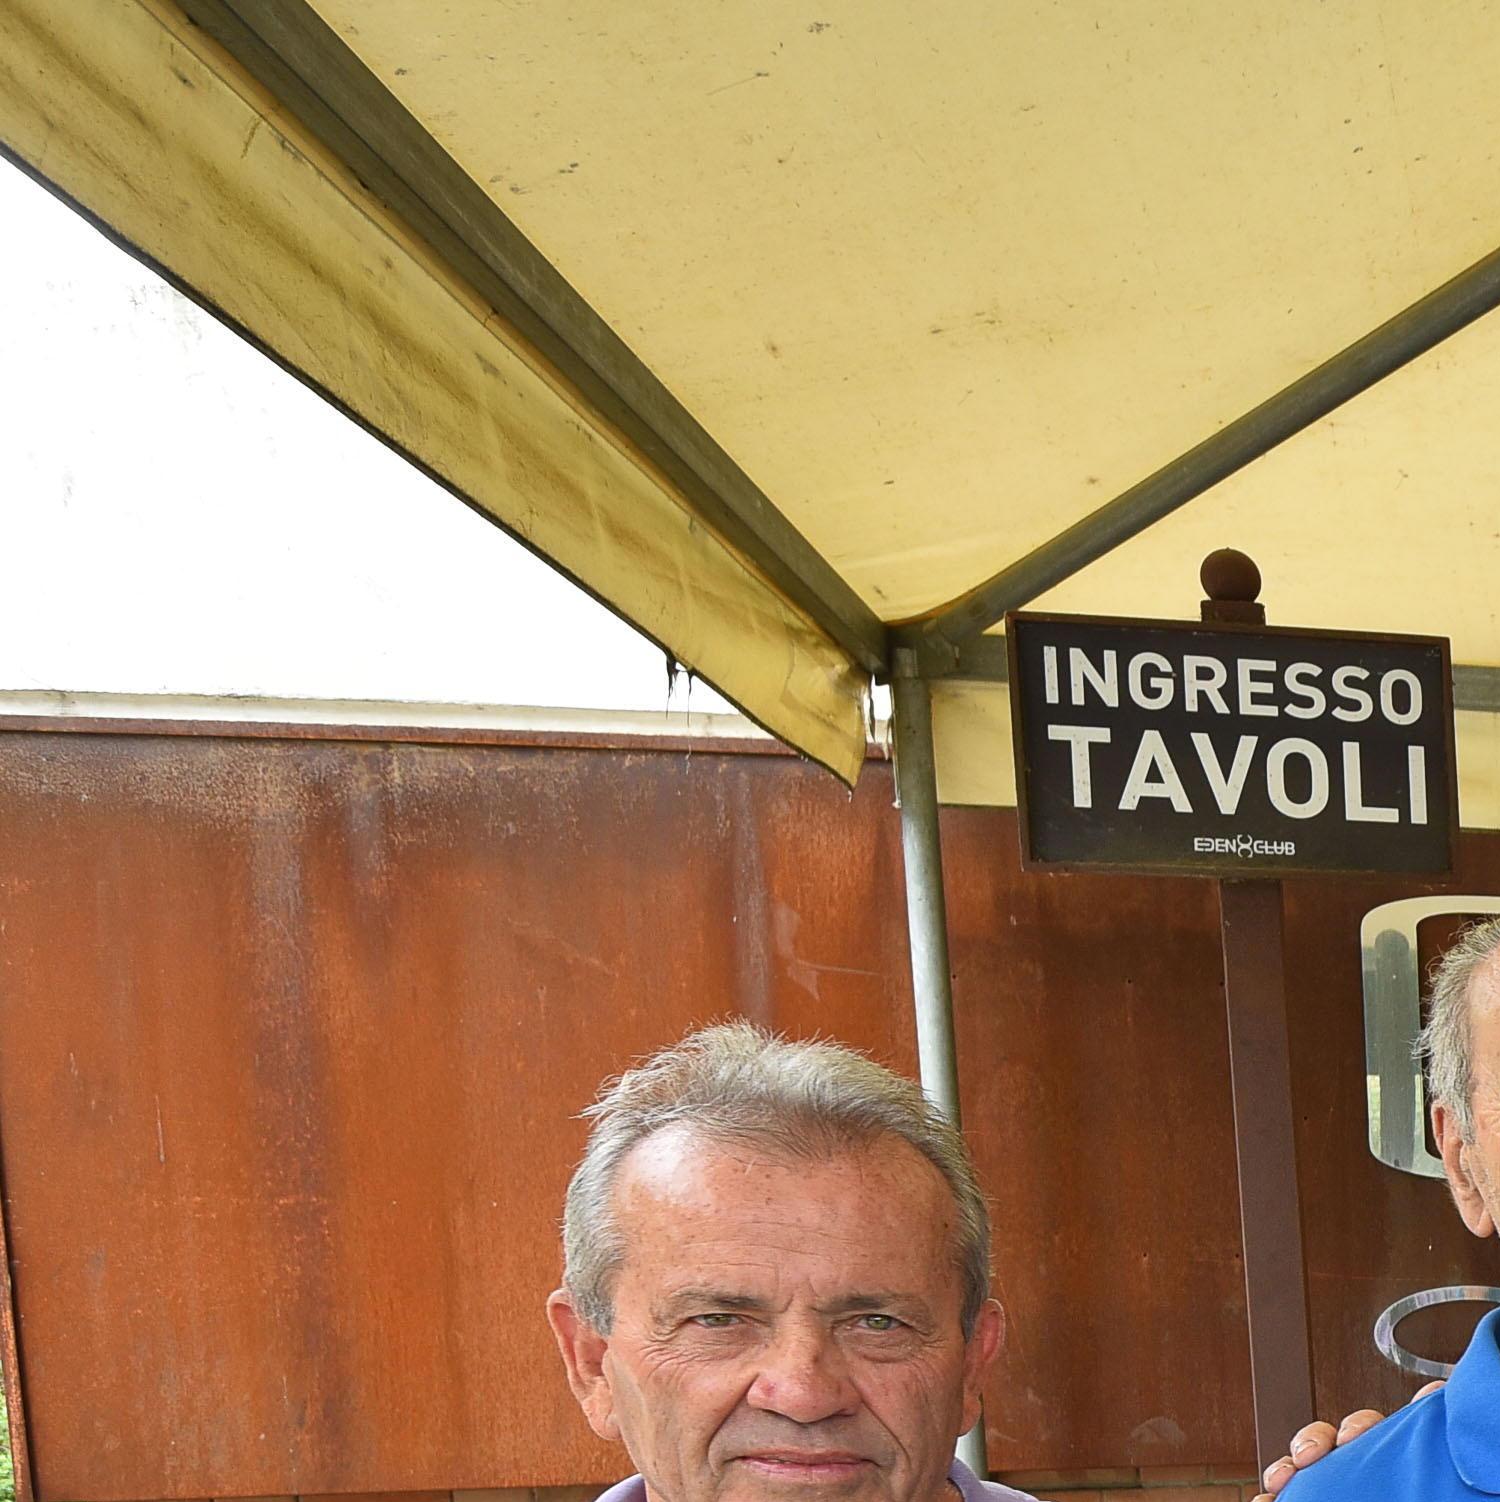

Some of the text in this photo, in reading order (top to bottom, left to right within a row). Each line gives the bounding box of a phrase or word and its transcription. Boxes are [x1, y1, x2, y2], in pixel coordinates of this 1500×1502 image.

[1043, 645, 1423, 726] INGRESSO
[1047, 724, 1428, 825] TAVOLI
[1194, 837, 1296, 856] EDEN CLUB
